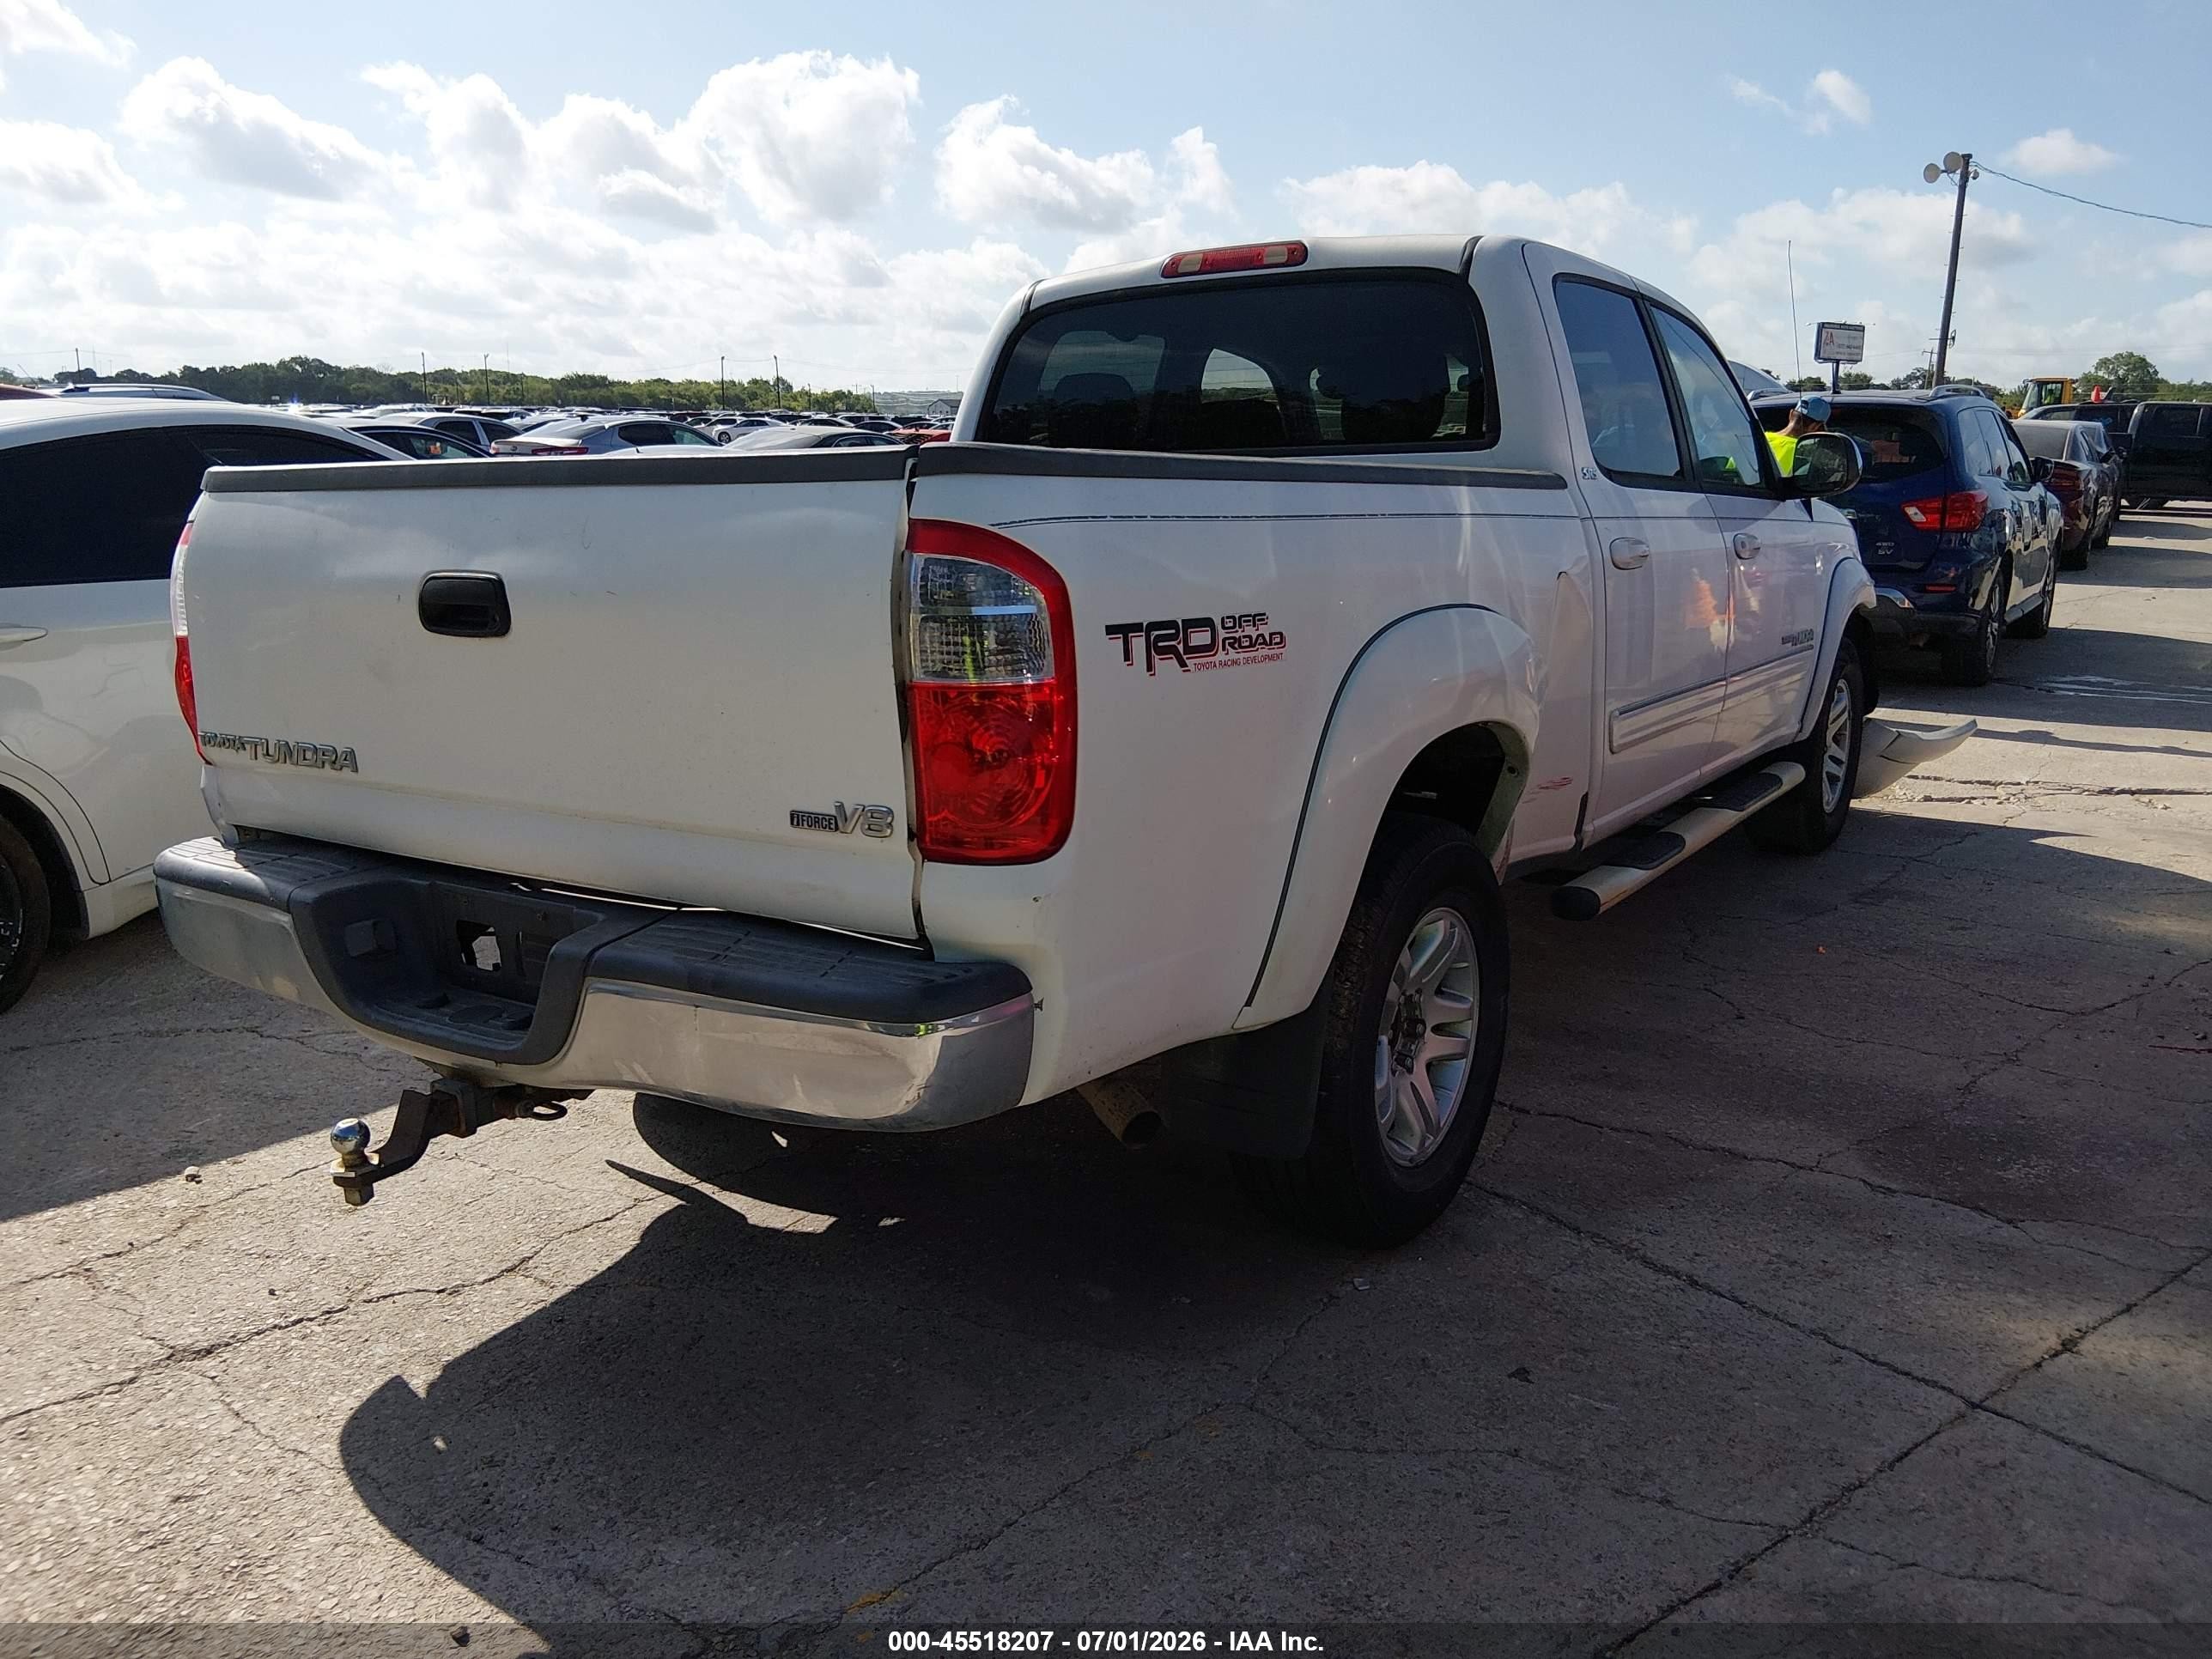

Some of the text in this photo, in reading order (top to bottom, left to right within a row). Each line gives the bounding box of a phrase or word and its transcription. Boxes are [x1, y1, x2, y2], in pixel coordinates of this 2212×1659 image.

[1221, 612, 1268, 634] OFF
[1105, 617, 1219, 677] TRD
[1221, 631, 1286, 654] ROAD
[1193, 653, 1284, 672] TOYOTA RACING DEVELOPMENT
[243, 736, 359, 774] TUNDRA
[834, 801, 895, 839] V8
